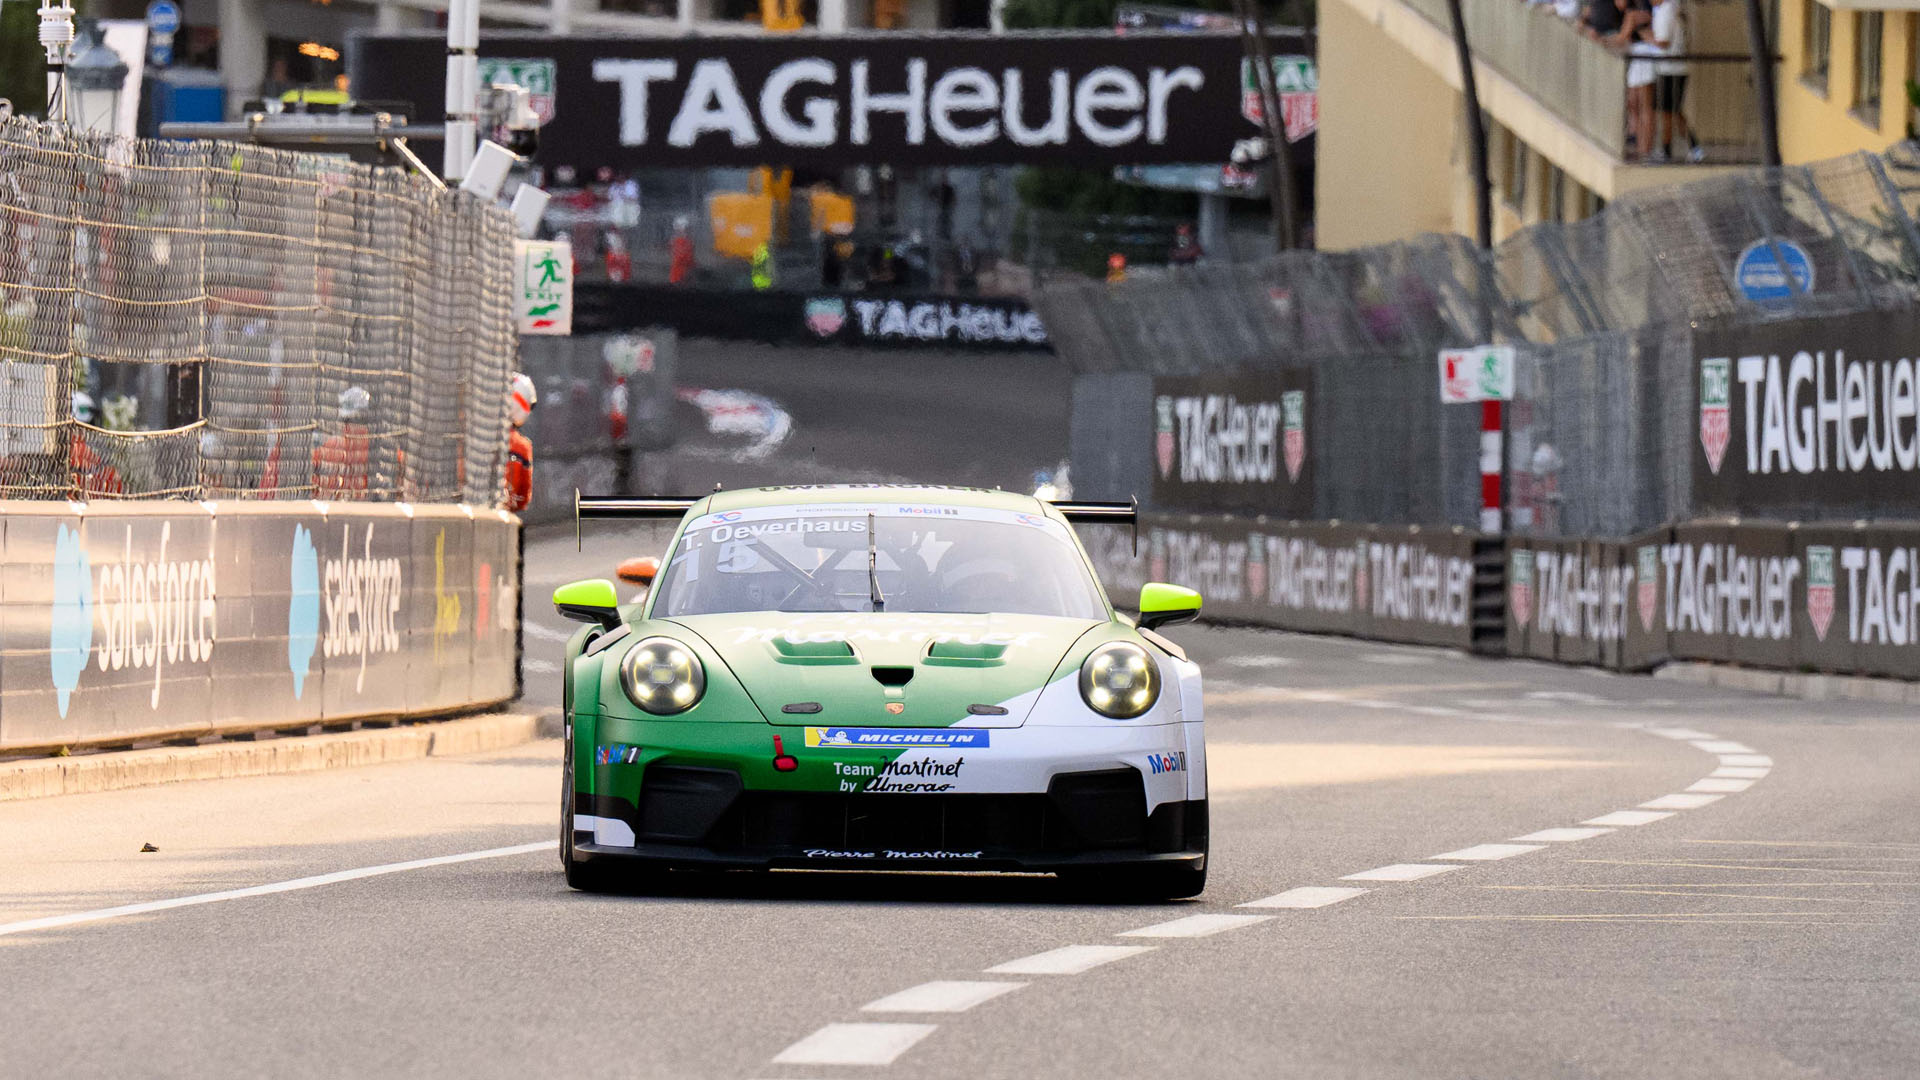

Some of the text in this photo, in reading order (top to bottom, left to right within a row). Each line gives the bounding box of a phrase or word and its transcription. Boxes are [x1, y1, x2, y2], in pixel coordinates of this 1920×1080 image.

[1737, 349, 1920, 475] TAGHeue
[899, 507, 942, 515] Mobil
[681, 518, 867, 551] T. Oeverhaus
[98, 521, 214, 710] salesforce
[323, 521, 401, 694] salesforce
[858, 734, 975, 743] MICHELIN
[833, 755, 964, 778] Team Martinet
[839, 779, 858, 793] by
[803, 849, 984, 859] Pierre Martinet
